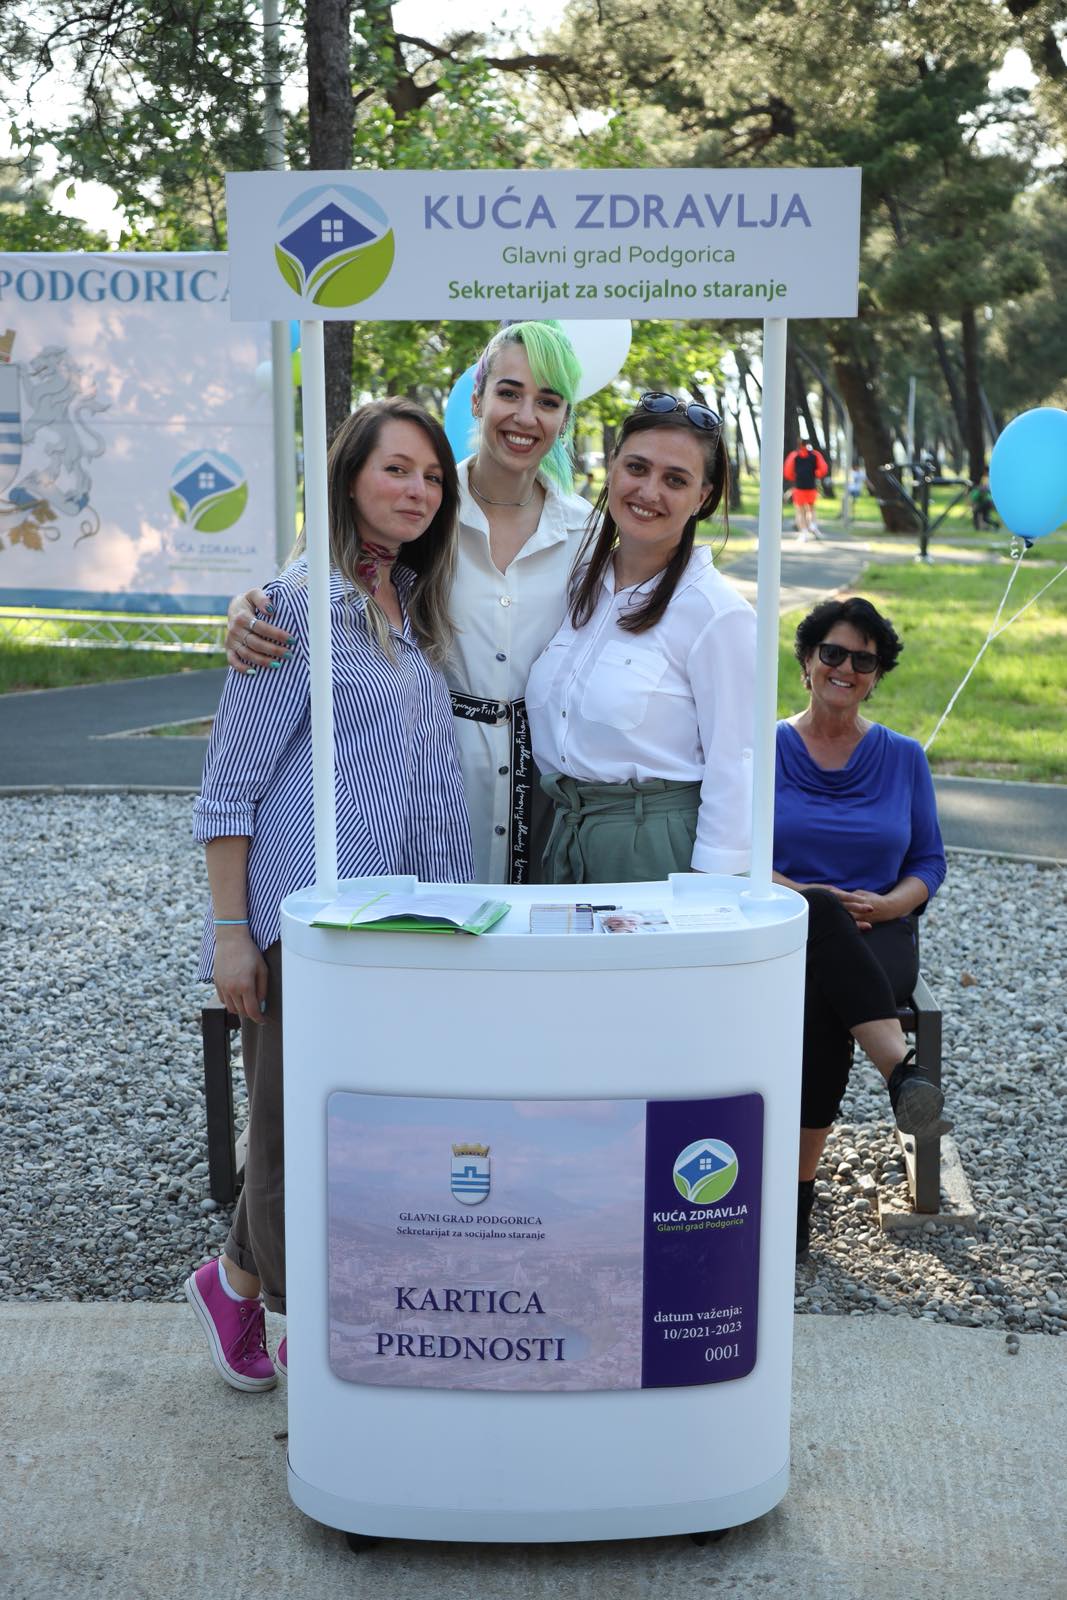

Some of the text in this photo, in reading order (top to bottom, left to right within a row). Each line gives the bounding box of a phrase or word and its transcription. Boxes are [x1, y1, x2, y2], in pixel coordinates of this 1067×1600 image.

[424, 186, 812, 230] KUĆA ZDRAVLJA
[502, 245, 736, 269] Glavni grad Podgorica
[0, 269, 230, 301] PODGORIC
[448, 279, 788, 304] Sekretarijat za socijalno staranje
[399, 1212, 543, 1225] GLAVNI GRAD PODGORICA
[653, 1204, 748, 1223] KUĆA ZDRAVLJA
[396, 1226, 450, 1238] Sekretarijat
[464, 1229, 506, 1240] socijalno
[508, 1231, 546, 1241] staranje
[657, 1218, 744, 1232] Glavni grad Podgorica
[395, 1286, 546, 1314] KARTICA
[653, 1305, 743, 1323] datum važenja:
[663, 1321, 742, 1340] 10/2021-2023
[375, 1332, 565, 1361] PREDNOSTI
[704, 1344, 741, 1362] 0001
